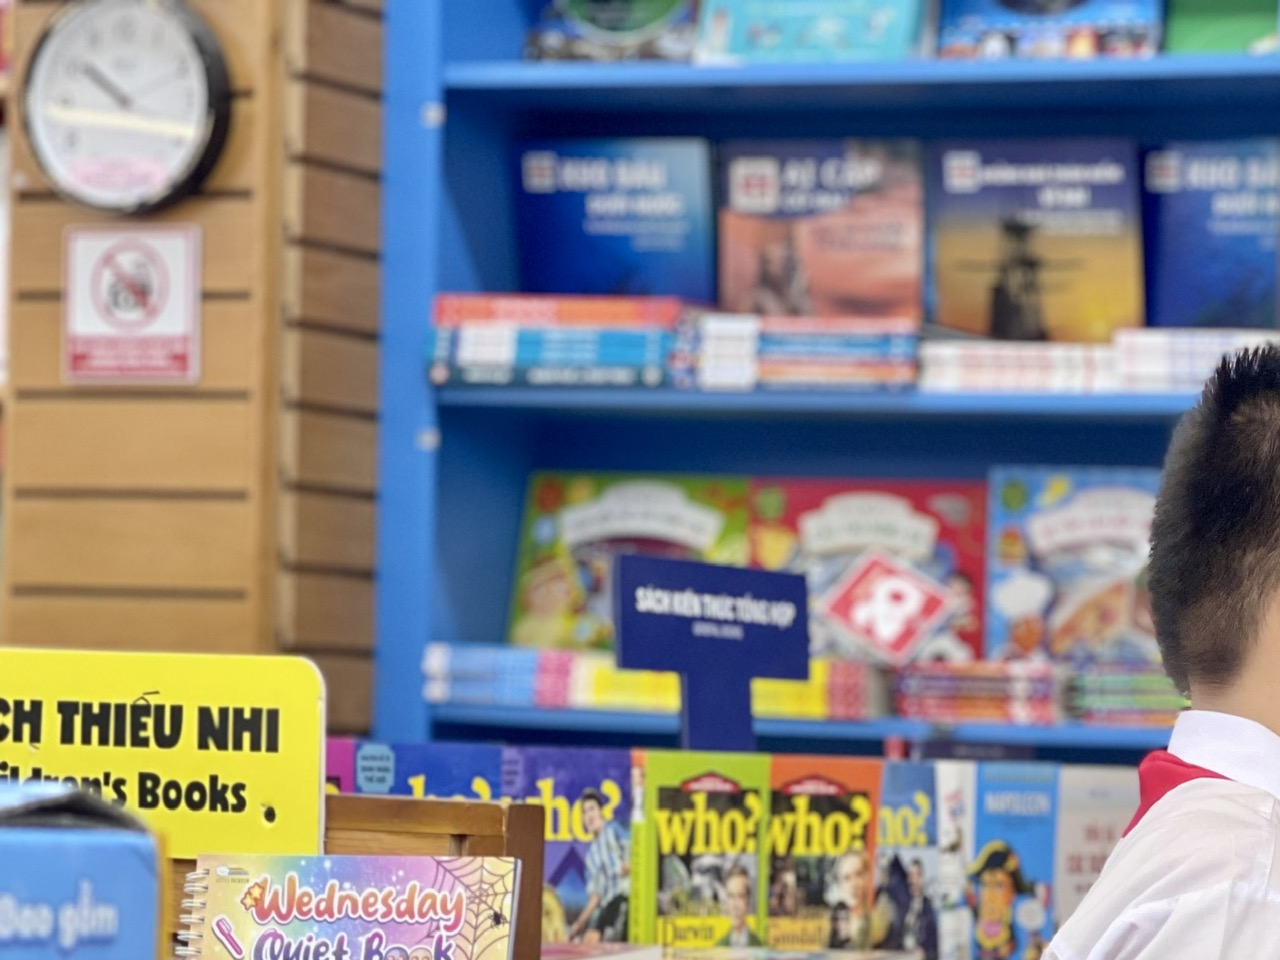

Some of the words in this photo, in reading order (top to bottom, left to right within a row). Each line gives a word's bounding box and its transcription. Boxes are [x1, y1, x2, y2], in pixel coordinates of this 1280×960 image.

[57, 691, 183, 750] THIẾU
[198, 706, 280, 753] NHI
[138, 772, 247, 813] Books
[656, 791, 762, 856] who?
[768, 794, 872, 857] who?
[253, 874, 465, 931] Wednesday
